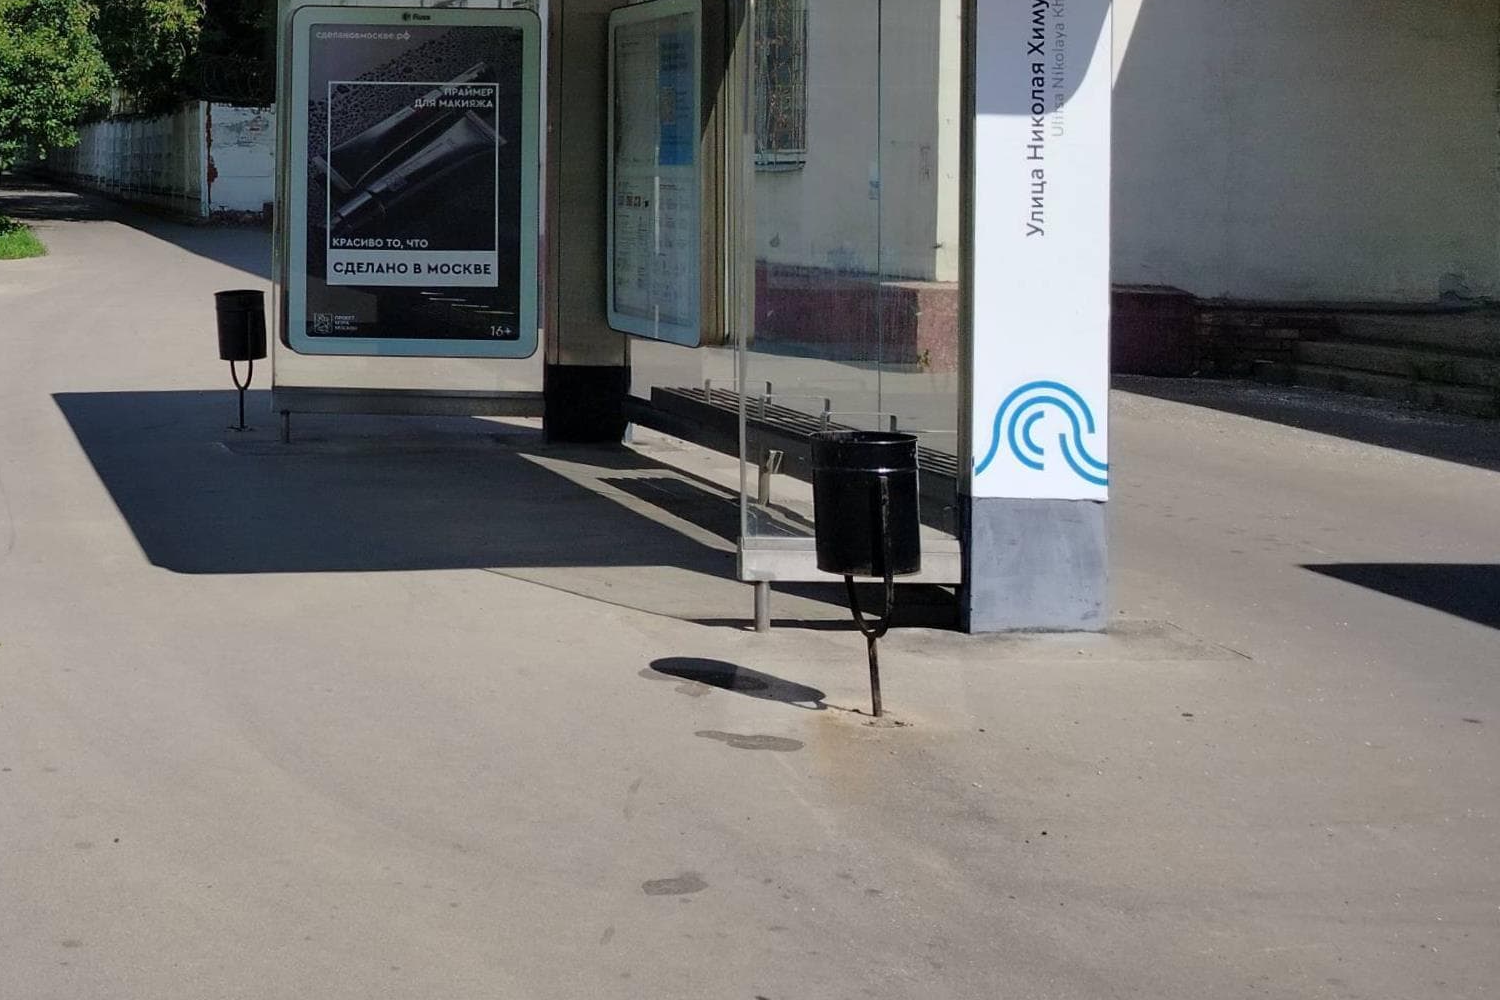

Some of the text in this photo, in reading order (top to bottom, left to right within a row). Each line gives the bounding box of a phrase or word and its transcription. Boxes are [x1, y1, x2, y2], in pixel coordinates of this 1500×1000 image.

[1051, 22, 1067, 88] Nikolaya
[444, 86, 494, 97] ПРАЙМЕР
[414, 98, 493, 109] ДЛЯ МАКИЯЖА
[1027, 62, 1045, 160] Николая
[1026, 168, 1047, 237] Улица
[332, 238, 429, 249] КРАСИВО ТО, ЧТО
[333, 262, 492, 275] СДЕЛАНО В МОСКВЕ
[490, 325, 513, 337] 16+
